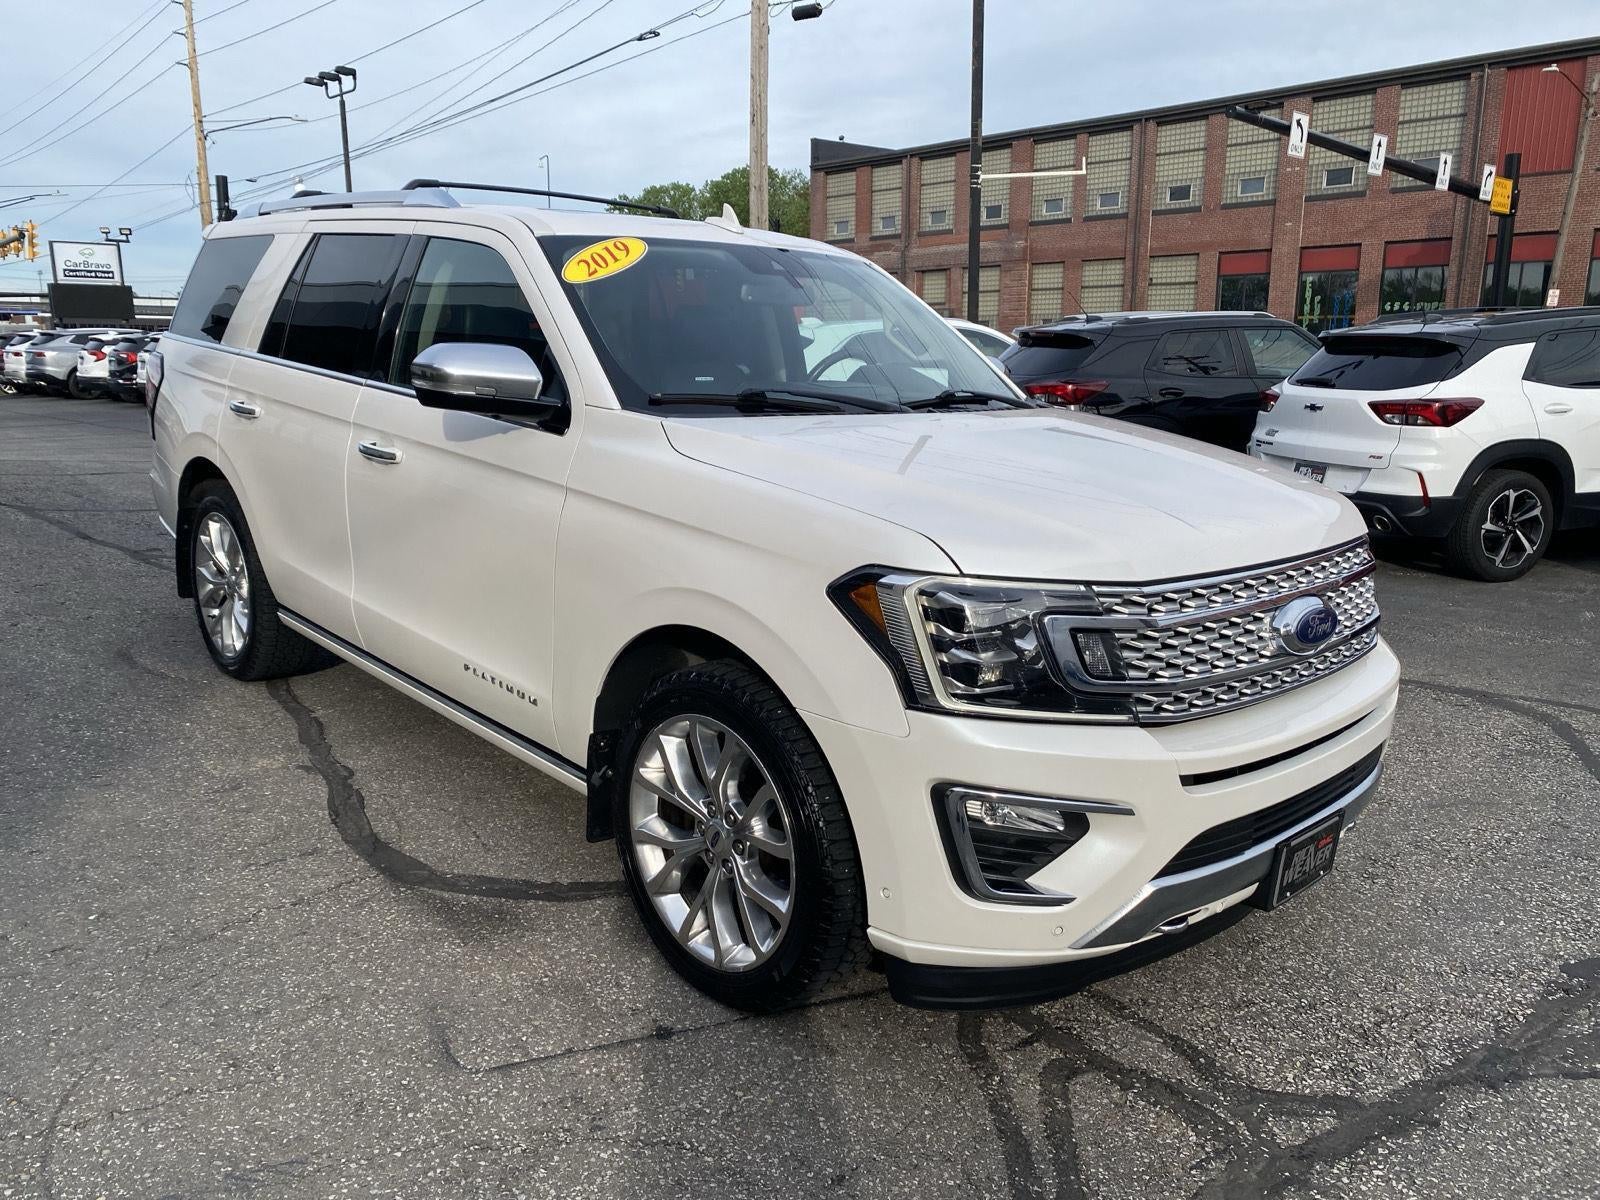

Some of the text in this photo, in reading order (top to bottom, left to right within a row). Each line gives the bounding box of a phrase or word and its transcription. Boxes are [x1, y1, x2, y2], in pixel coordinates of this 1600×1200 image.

[64, 259, 111, 269] CarBravo
[577, 240, 630, 277] 2019
[1308, 612, 1332, 639] Ford
[463, 663, 538, 707] PLATINUM
[1283, 843, 1333, 887] WEAVER
